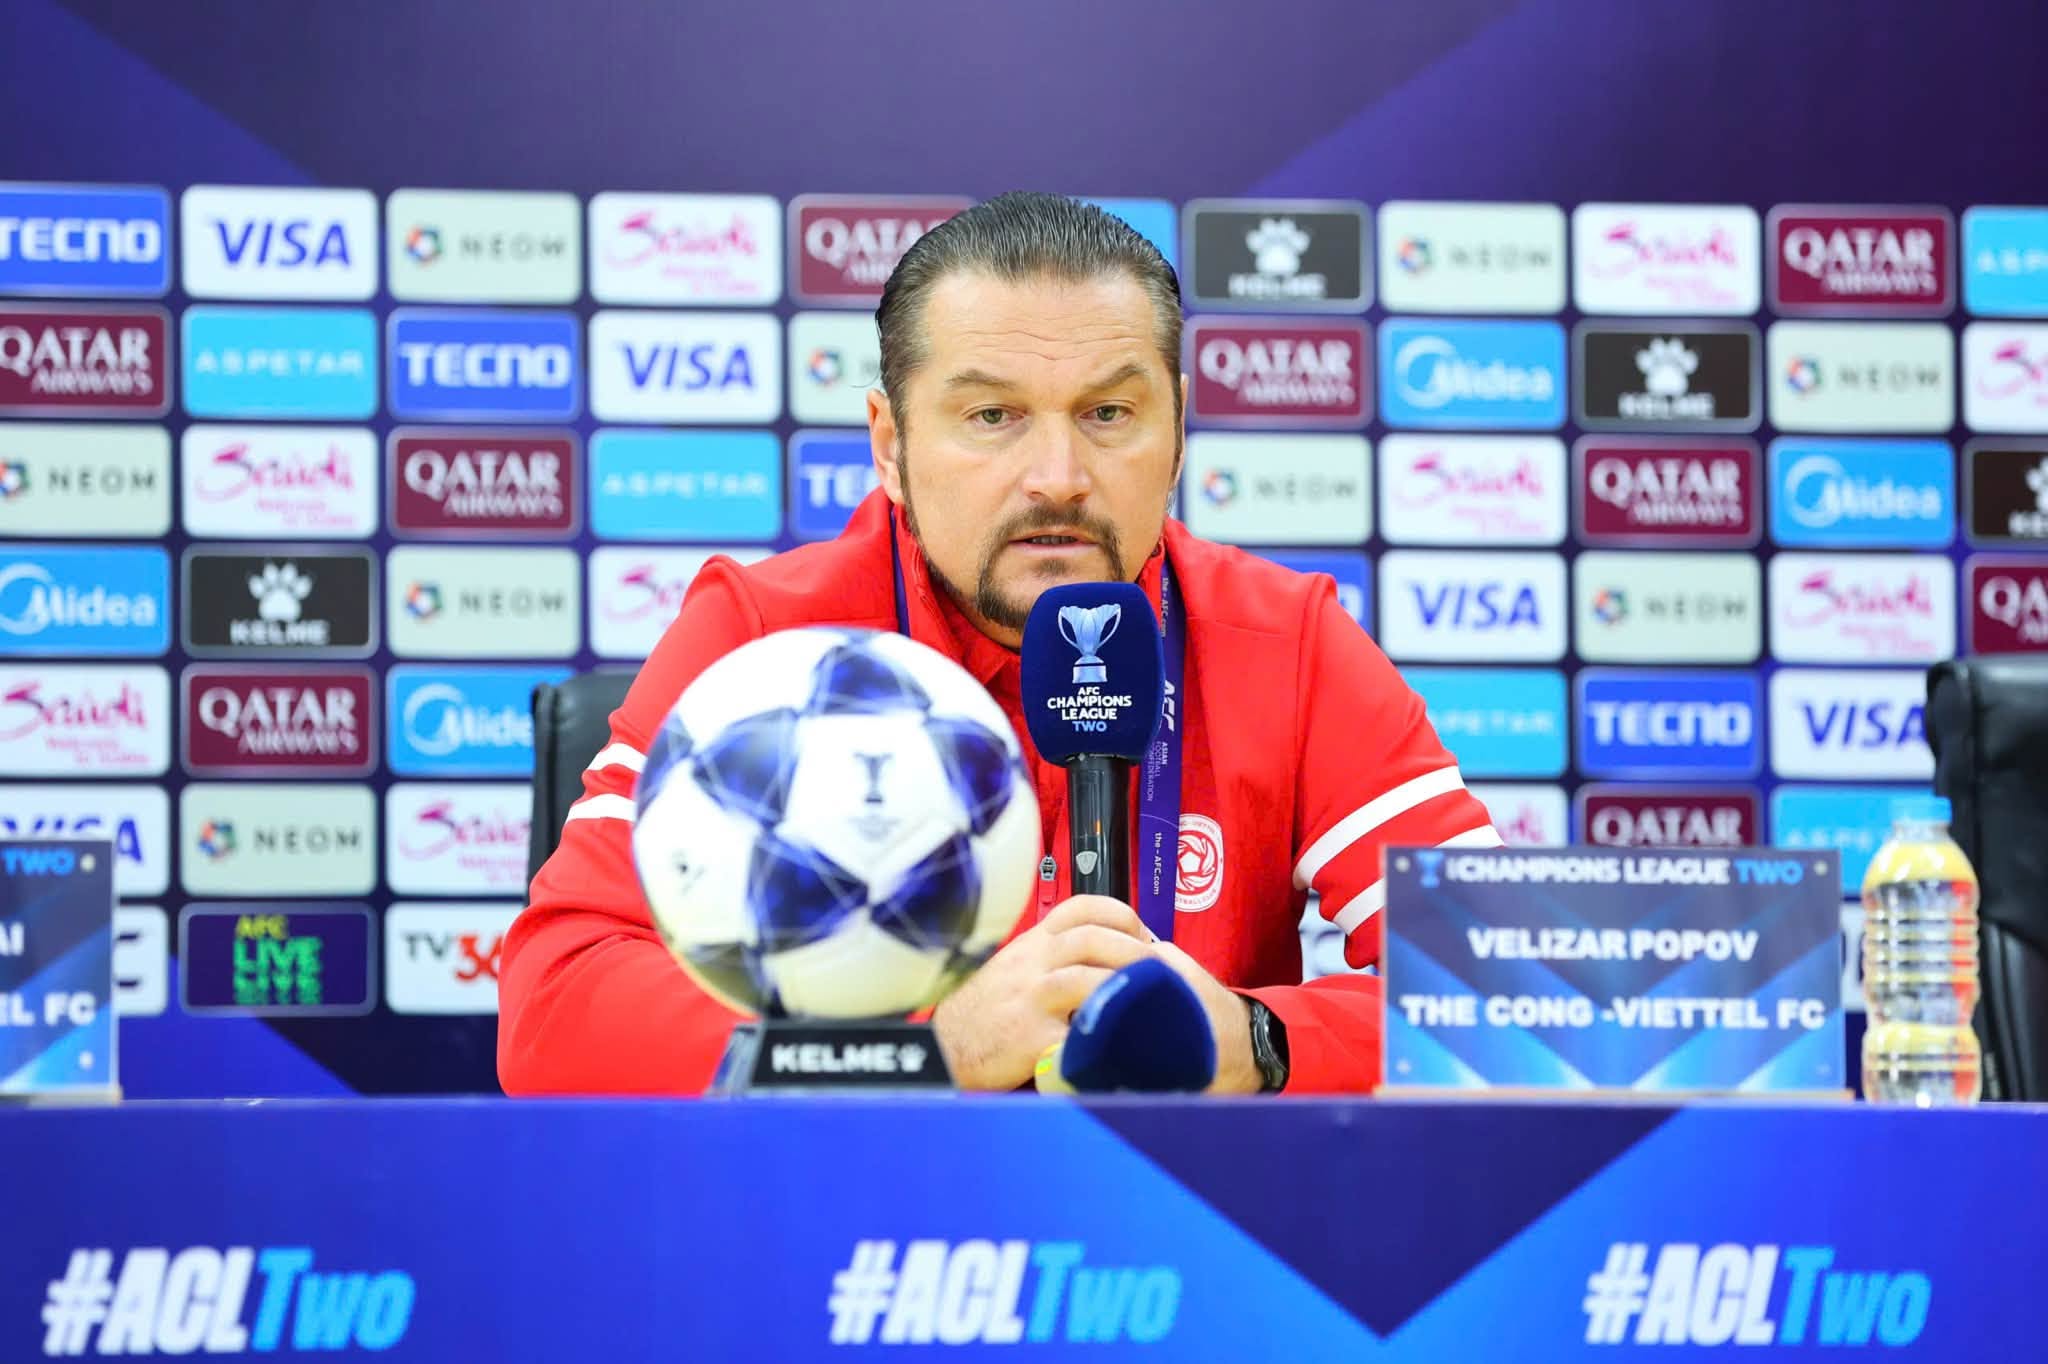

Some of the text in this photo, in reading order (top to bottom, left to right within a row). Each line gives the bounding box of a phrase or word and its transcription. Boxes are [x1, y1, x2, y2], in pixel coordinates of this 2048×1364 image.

[0, 217, 161, 263] TECNO
[213, 219, 351, 268] VISA
[461, 234, 566, 259] NEOM
[1783, 227, 1935, 278] QATAR
[0, 325, 151, 377] QATAR
[400, 341, 571, 389] TECNO
[619, 344, 755, 391] VISA
[1199, 337, 1352, 390] QATAR
[31, 369, 153, 395] AIRWAYS
[48, 470, 156, 491] NEOM
[404, 449, 561, 501] QATAR
[1589, 458, 1741, 509] QATAR
[443, 492, 564, 518] AIRWAYS
[30, 585, 157, 627] Midea
[458, 593, 565, 613] NEOM
[1411, 583, 1543, 630] VISA
[230, 620, 330, 645] KELME
[1046, 695, 1133, 710] CHAMPIONS
[1077, 686, 1101, 696] AFC
[199, 686, 356, 739] QATAR
[1061, 707, 1118, 721] LEAGUE
[1071, 720, 1108, 733] TWO
[1588, 700, 1752, 746] TECNO
[1801, 702, 1929, 748] VISA
[239, 729, 359, 755] AIRWAYS
[254, 827, 362, 853] NEOM
[1591, 807, 1742, 846] QATAR
[4, 849, 76, 876] TWO
[1459, 856, 1620, 884] CHAMPIONS
[1623, 858, 1730, 885] LEAGUE
[1735, 858, 1804, 885] TWO
[1467, 928, 1760, 961] VELIZAR POPOV
[44, 991, 97, 1025] FC
[1401, 994, 1479, 1027] THE
[1485, 995, 1596, 1028] CONG
[1777, 999, 1826, 1030] FC
[771, 1043, 898, 1072] KELME
